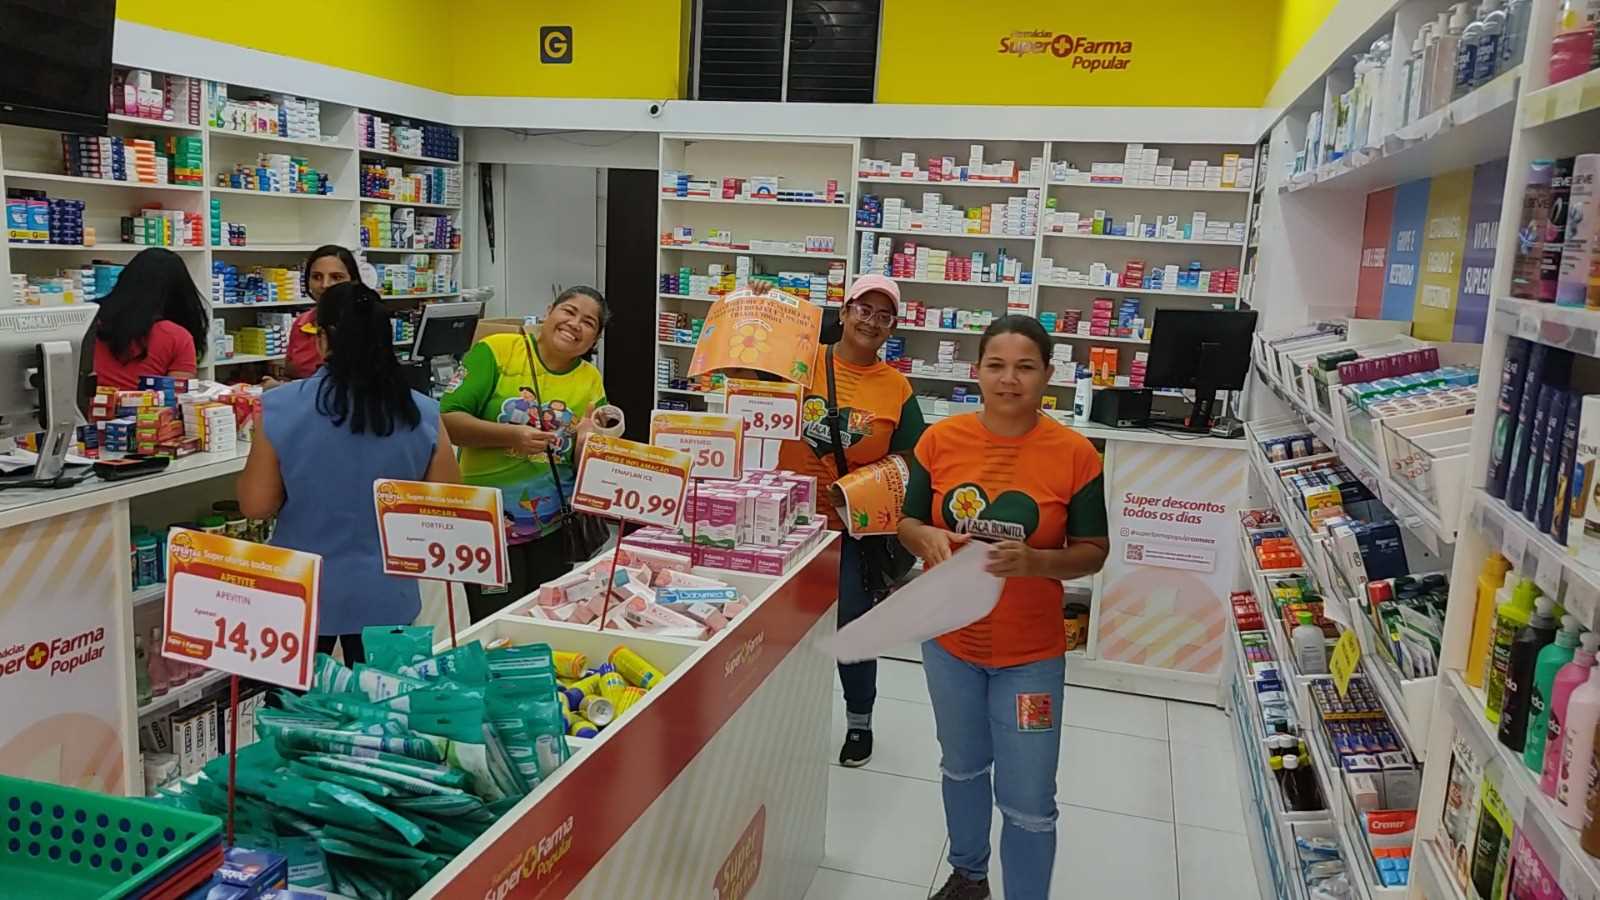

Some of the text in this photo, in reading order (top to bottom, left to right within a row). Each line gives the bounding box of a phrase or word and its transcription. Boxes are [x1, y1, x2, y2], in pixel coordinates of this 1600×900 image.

[544, 31, 568, 58] G
[999, 37, 1132, 57] Super Farma
[1072, 56, 1131, 73] Popular
[753, 412, 793, 431] 8,99
[613, 488, 677, 516] 10,99
[1123, 492, 1226, 514] Super descontos
[1123, 506, 1202, 525] todos os dias
[428, 542, 492, 575] 9,99
[220, 572, 257, 588] APETITE
[50, 626, 105, 660] Farma
[215, 616, 299, 664] 14,99
[50, 645, 105, 677] Popular
[1371, 820, 1405, 830] Cremer
[537, 815, 573, 862] Farma
